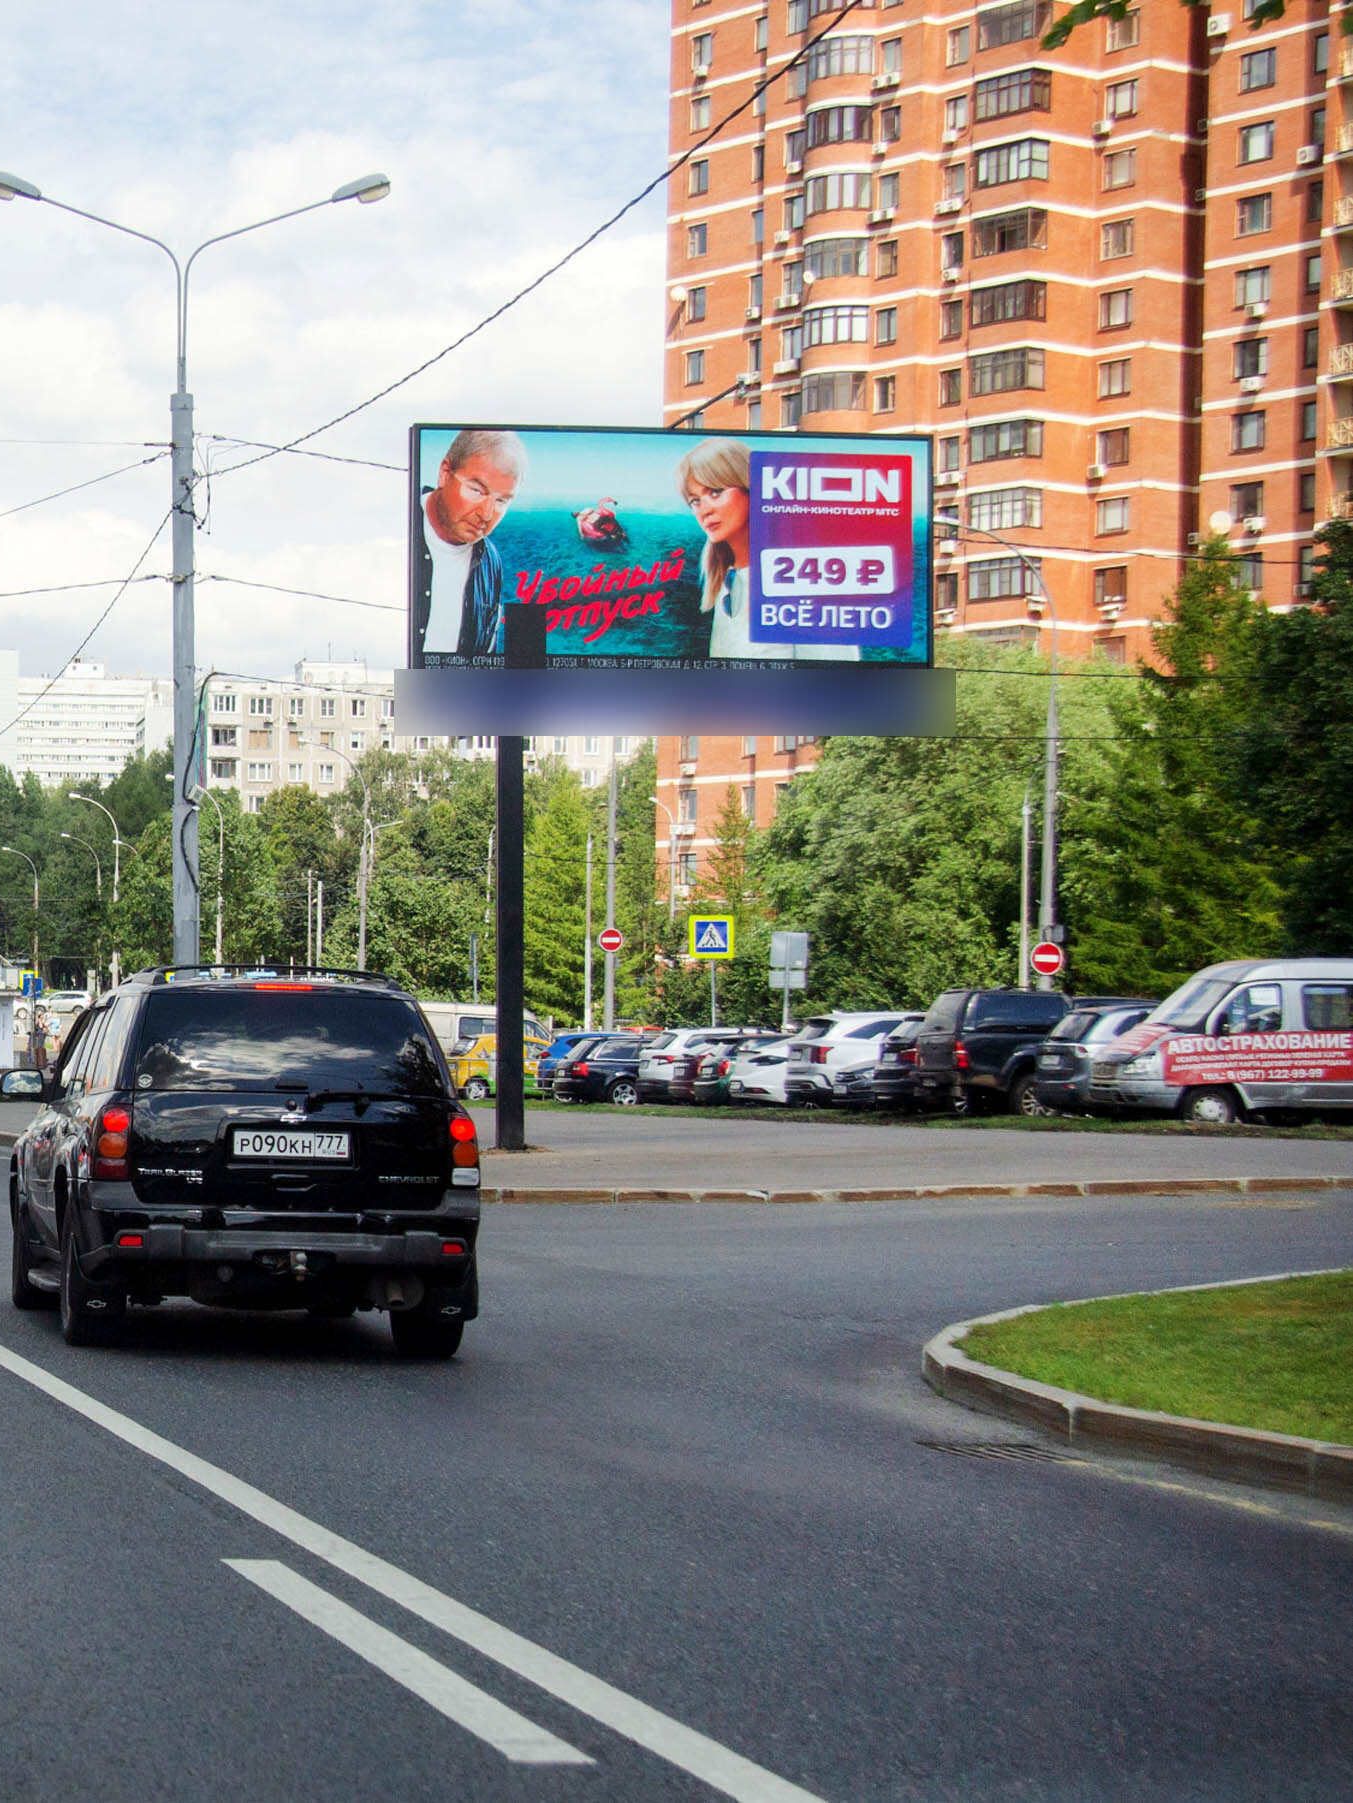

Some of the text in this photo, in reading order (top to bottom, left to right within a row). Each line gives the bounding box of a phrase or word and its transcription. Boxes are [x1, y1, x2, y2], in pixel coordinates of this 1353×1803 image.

[761, 466, 901, 503] KION
[761, 503, 900, 517] ОНЛАЙН-КИНОТЕАТР МТС
[772, 556, 847, 586] 249
[760, 599, 893, 630] ВСЁ ЛЕТО
[1167, 1033, 1353, 1055] АВТОСТРАХОВАНИЕ
[316, 1134, 344, 1150] 777
[378, 1175, 441, 1185] CHEVROLET
